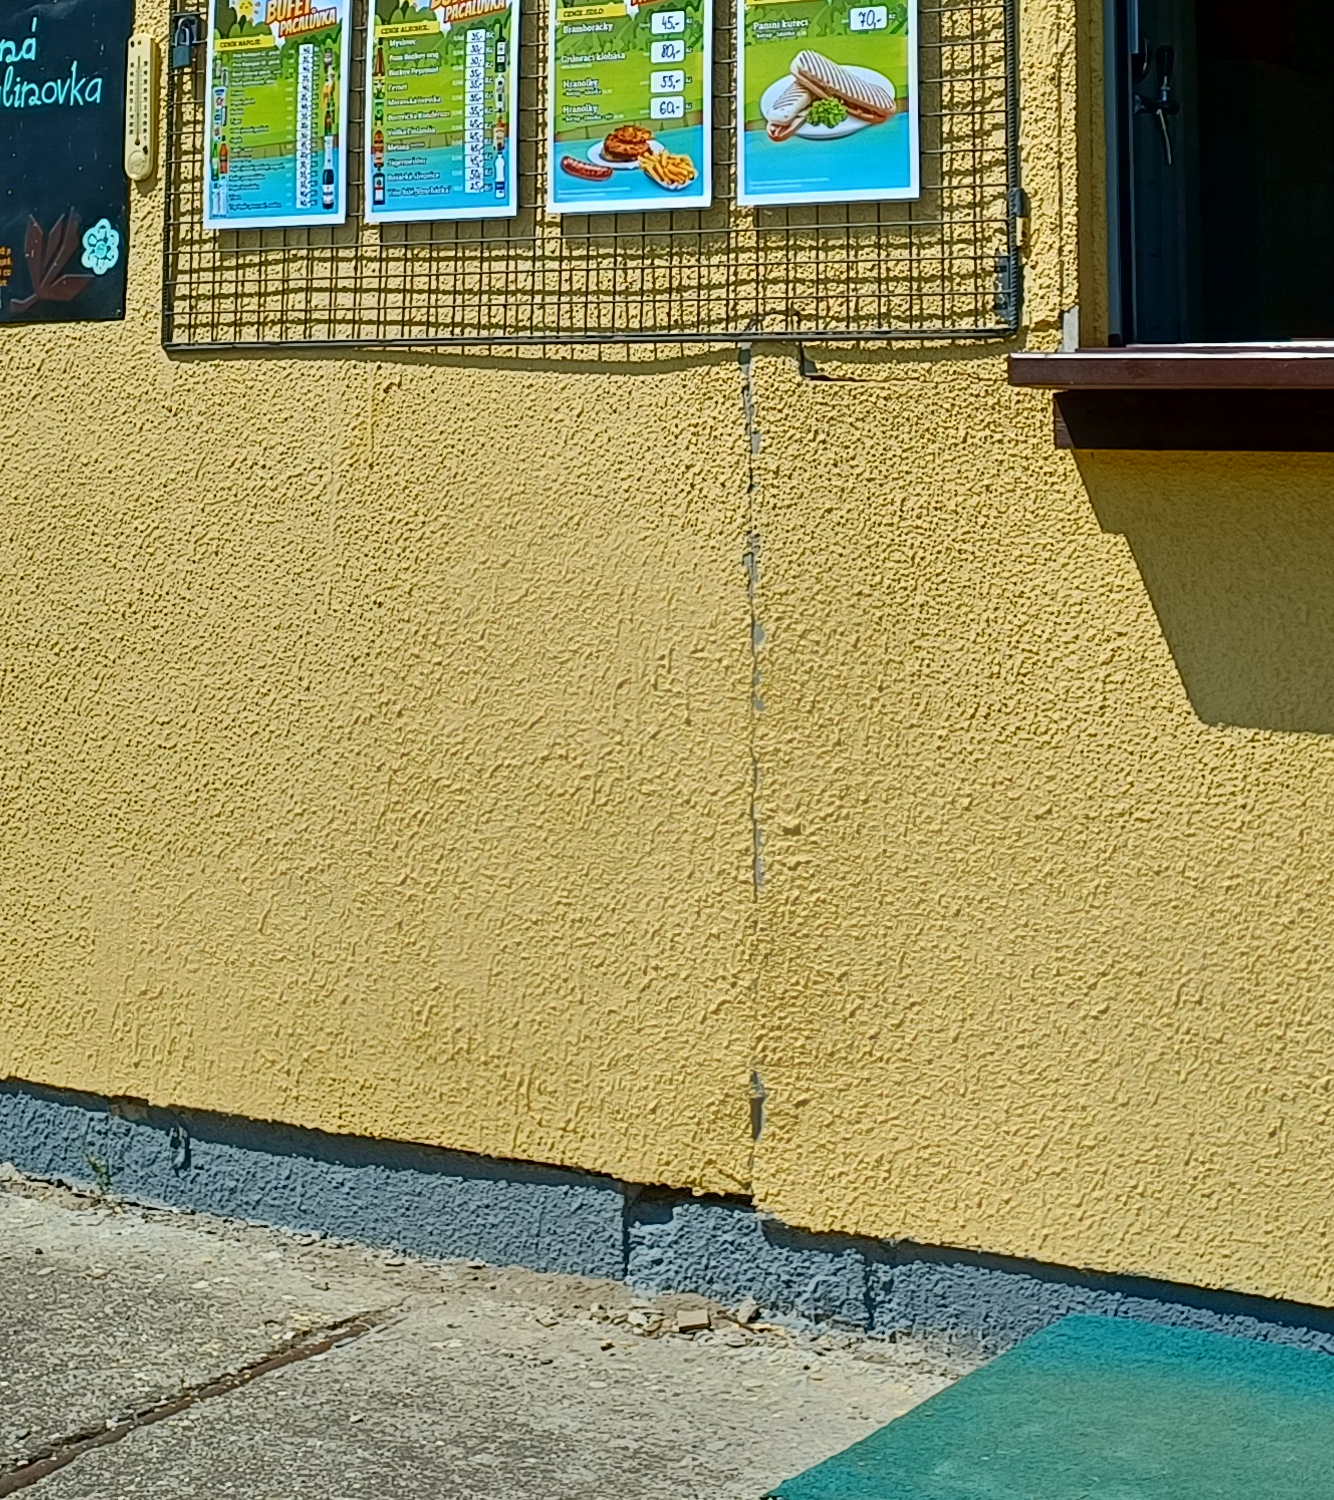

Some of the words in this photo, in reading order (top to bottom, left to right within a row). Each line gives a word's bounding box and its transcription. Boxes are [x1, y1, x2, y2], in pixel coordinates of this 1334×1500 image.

[279, 7, 337, 37] PACALŮVKA
[858, 10, 882, 29] 70,-
[563, 78, 599, 88] Hranolky
[563, 104, 599, 114] Hranolky
